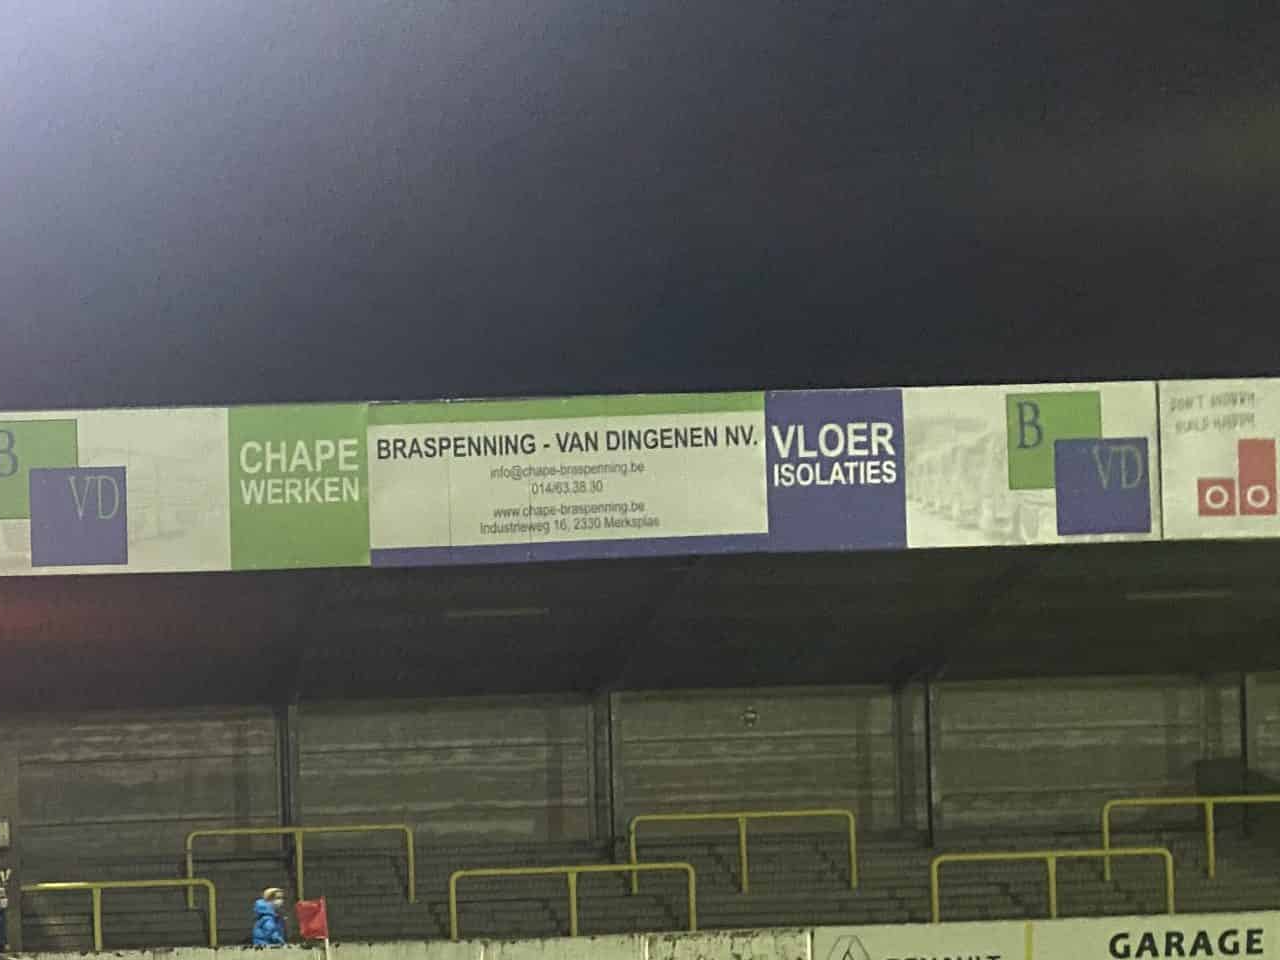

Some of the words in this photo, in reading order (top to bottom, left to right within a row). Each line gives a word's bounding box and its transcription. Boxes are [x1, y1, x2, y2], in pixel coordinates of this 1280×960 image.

[376, 433, 537, 460] BRASPENNING
[555, 430, 599, 453] VAN
[606, 425, 719, 452] DINGENEN
[725, 424, 759, 446] NV.
[771, 421, 894, 459] VLOER
[1016, 400, 1044, 450] B
[239, 438, 360, 475] CHAPE
[772, 460, 897, 488] ISOLATIES
[1091, 444, 1145, 491] VD
[69, 474, 120, 521] VD
[240, 477, 361, 506] WERKEN
[574, 517, 601, 531] 2330
[1108, 928, 1264, 959] GARAGE
